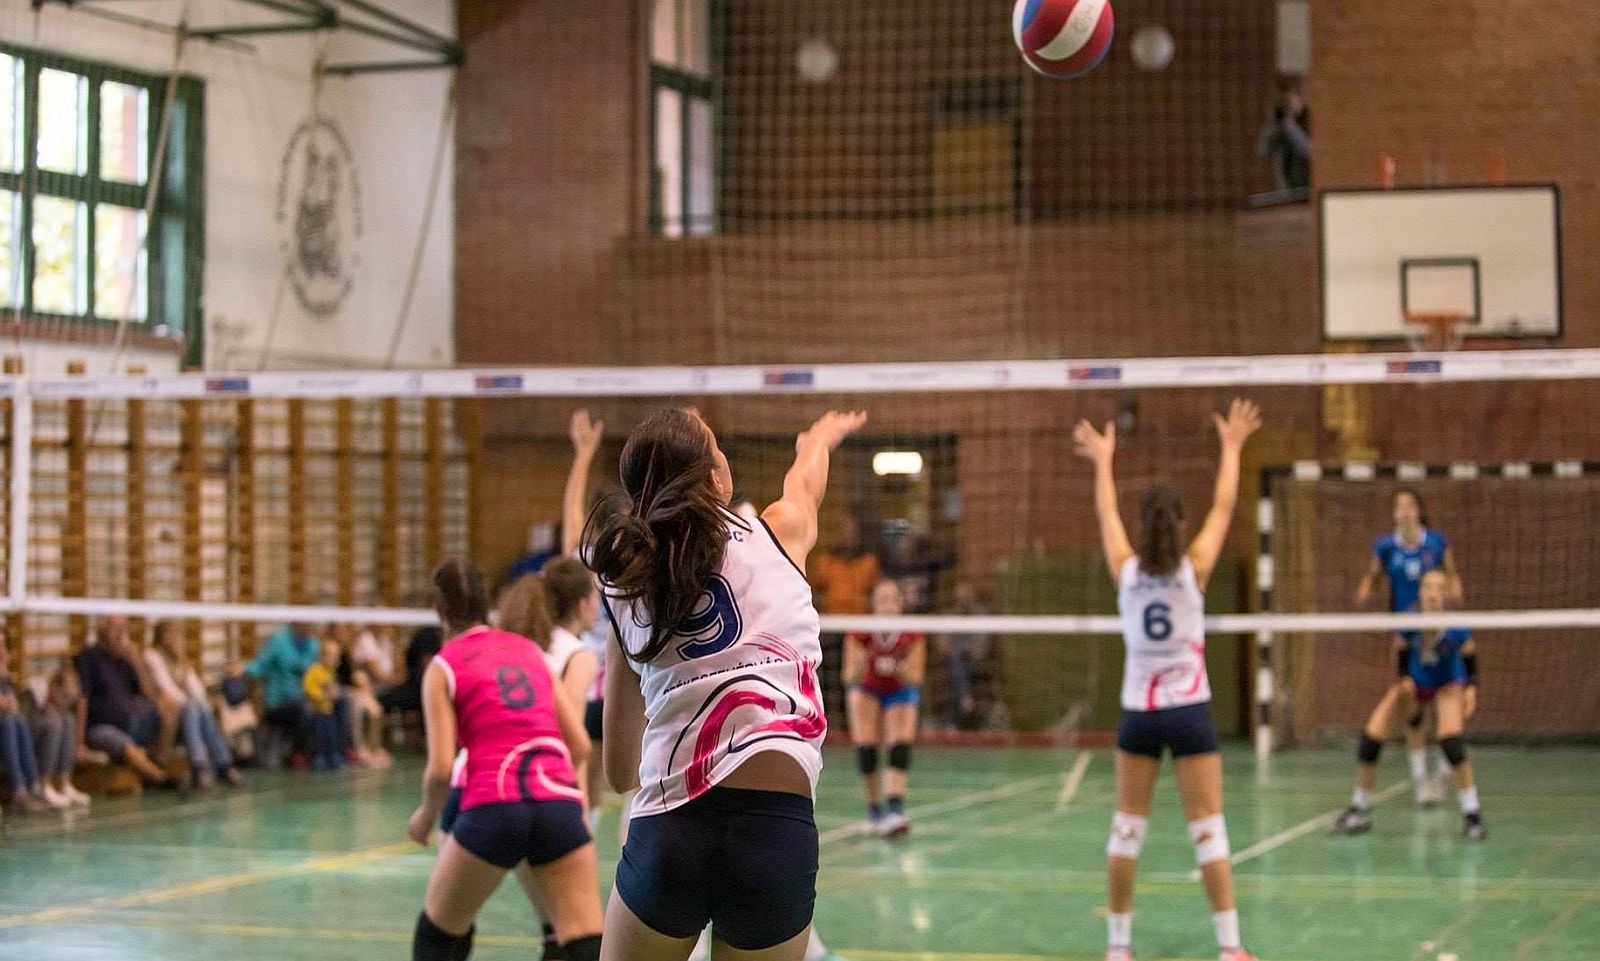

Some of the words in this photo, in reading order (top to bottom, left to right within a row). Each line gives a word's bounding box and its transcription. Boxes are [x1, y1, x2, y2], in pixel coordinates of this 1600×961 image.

[675, 573, 743, 661] 9
[1143, 601, 1173, 642] 6
[496, 663, 538, 710] 8
